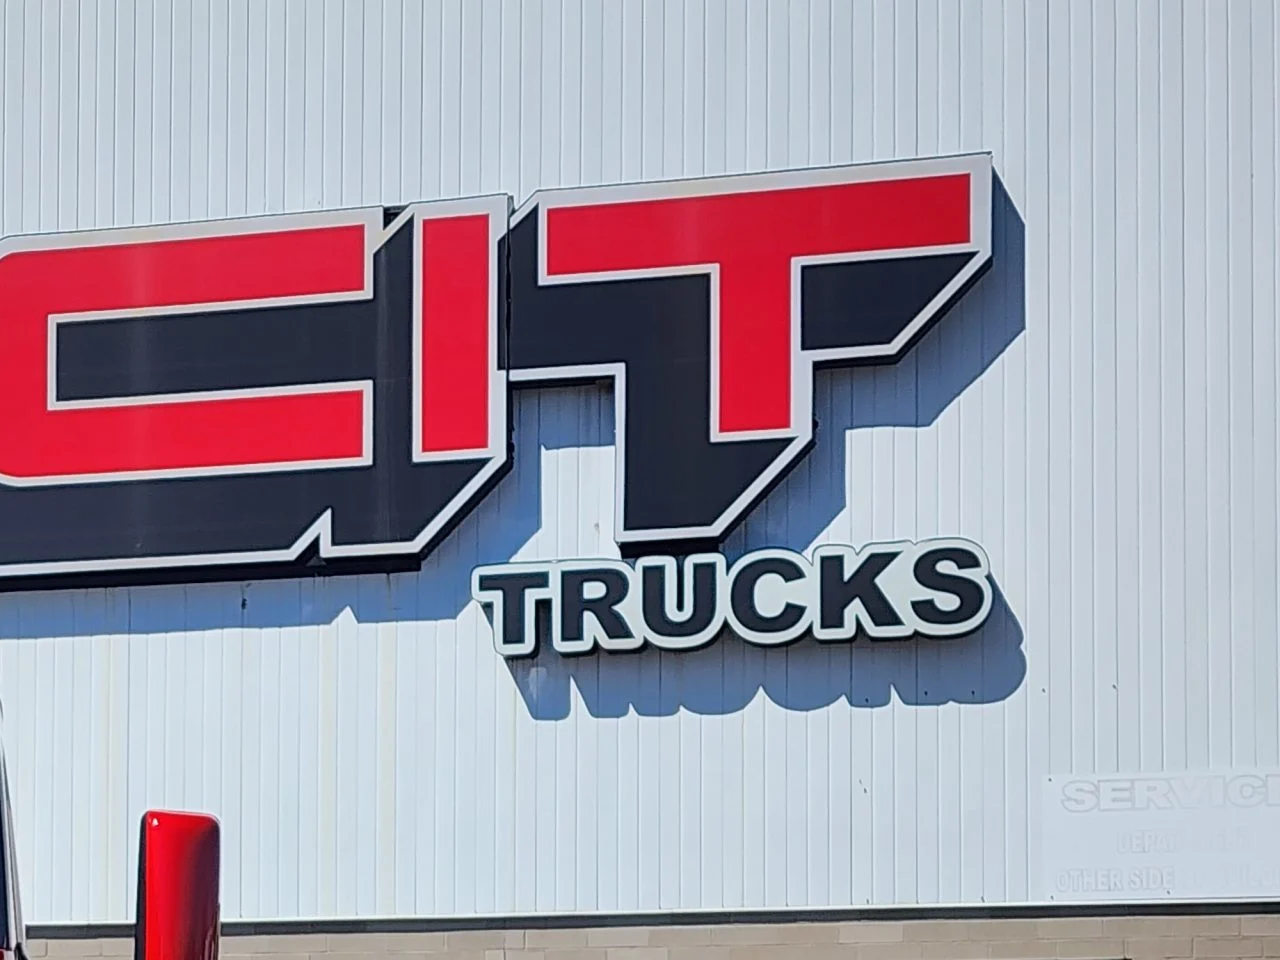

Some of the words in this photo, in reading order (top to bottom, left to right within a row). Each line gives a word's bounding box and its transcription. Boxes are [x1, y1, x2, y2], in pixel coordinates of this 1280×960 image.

[477, 545, 986, 647] TRUCKS
[1055, 867, 1124, 893] OTHER
[1128, 865, 1176, 891] SIDE
